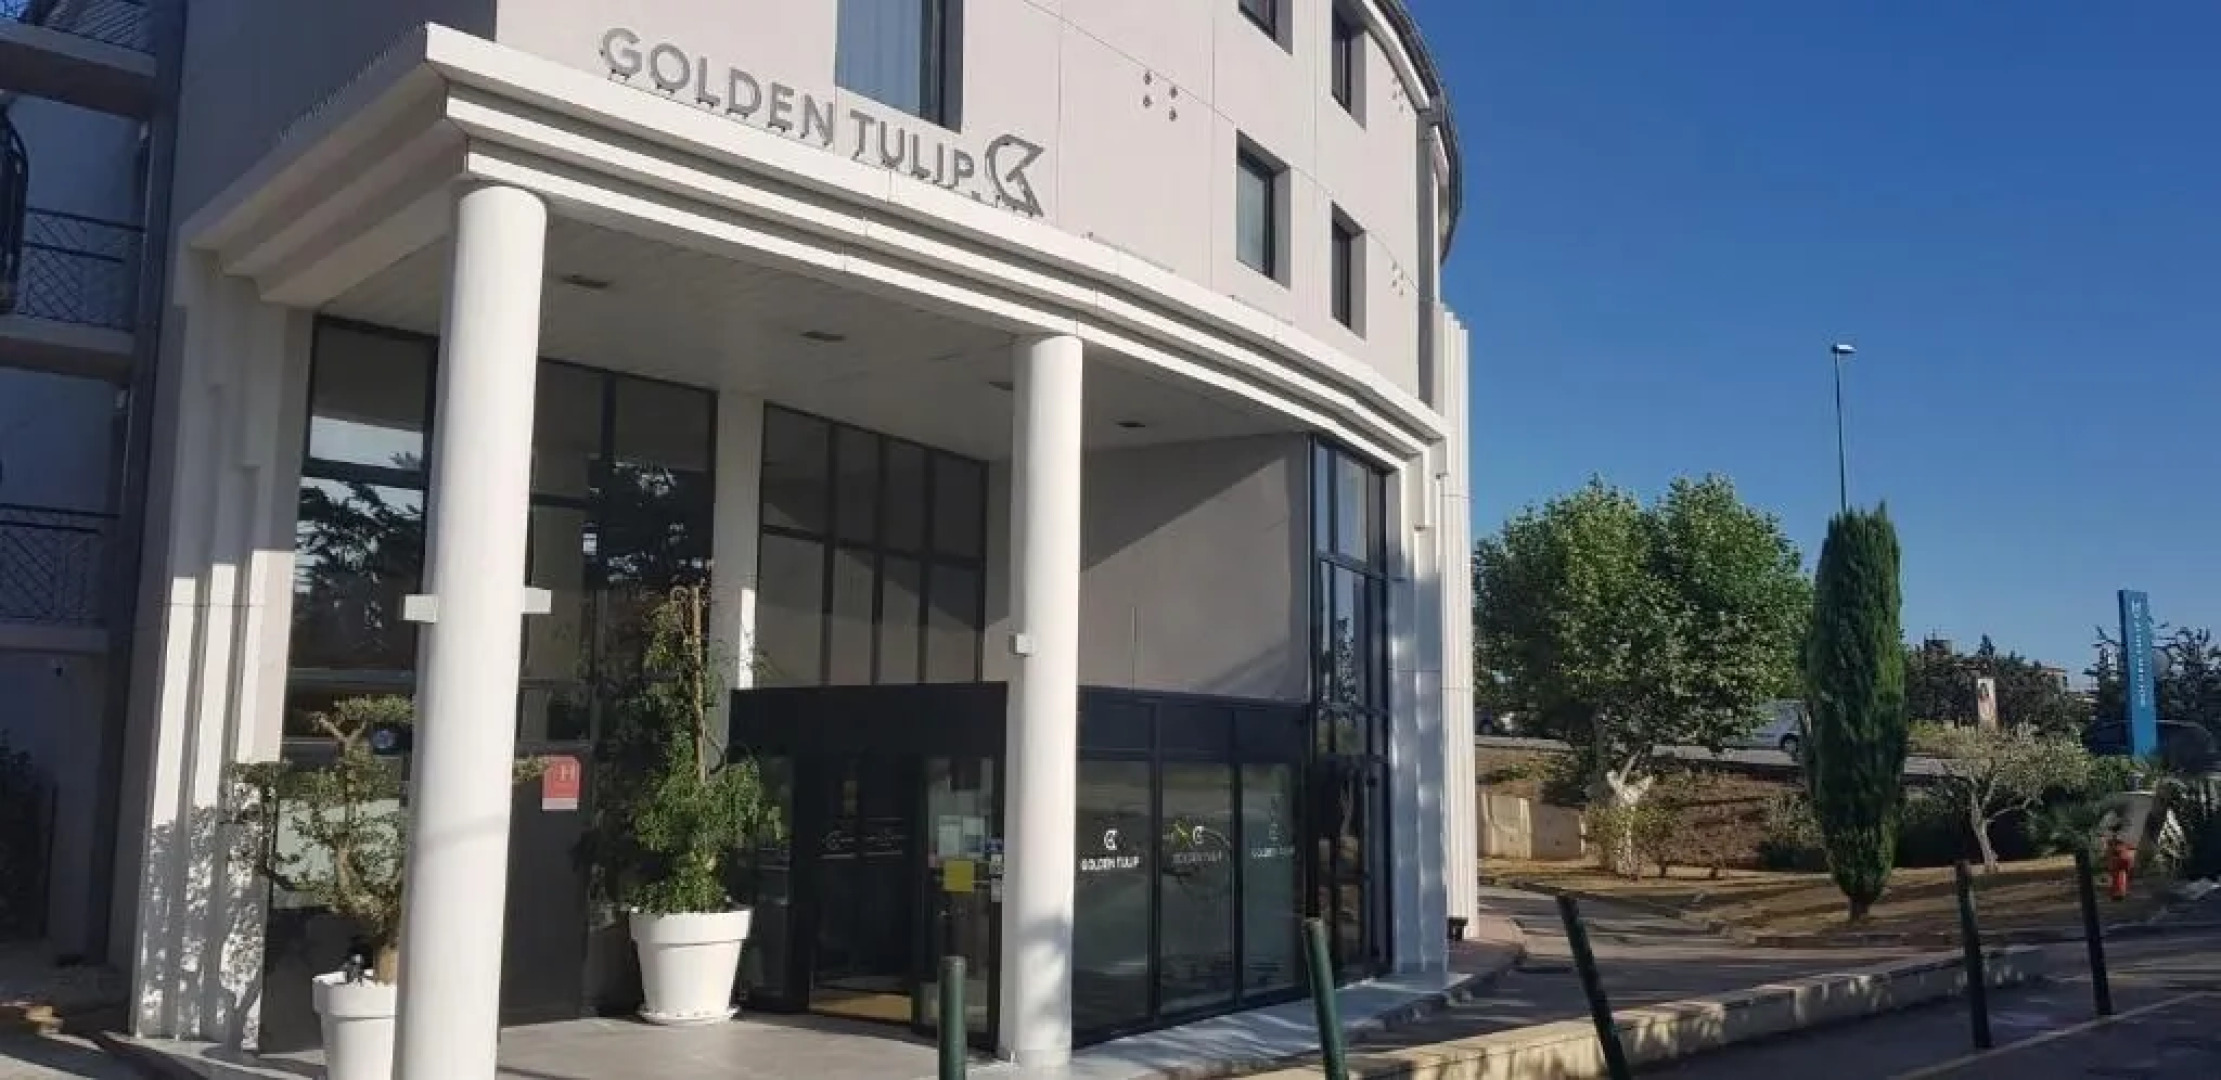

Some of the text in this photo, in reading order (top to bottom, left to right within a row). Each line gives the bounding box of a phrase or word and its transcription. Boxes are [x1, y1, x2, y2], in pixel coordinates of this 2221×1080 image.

[601, 27, 975, 190] GOLDEN TULIP
[561, 763, 576, 781] H
[1081, 858, 1115, 871] GOLDEN
